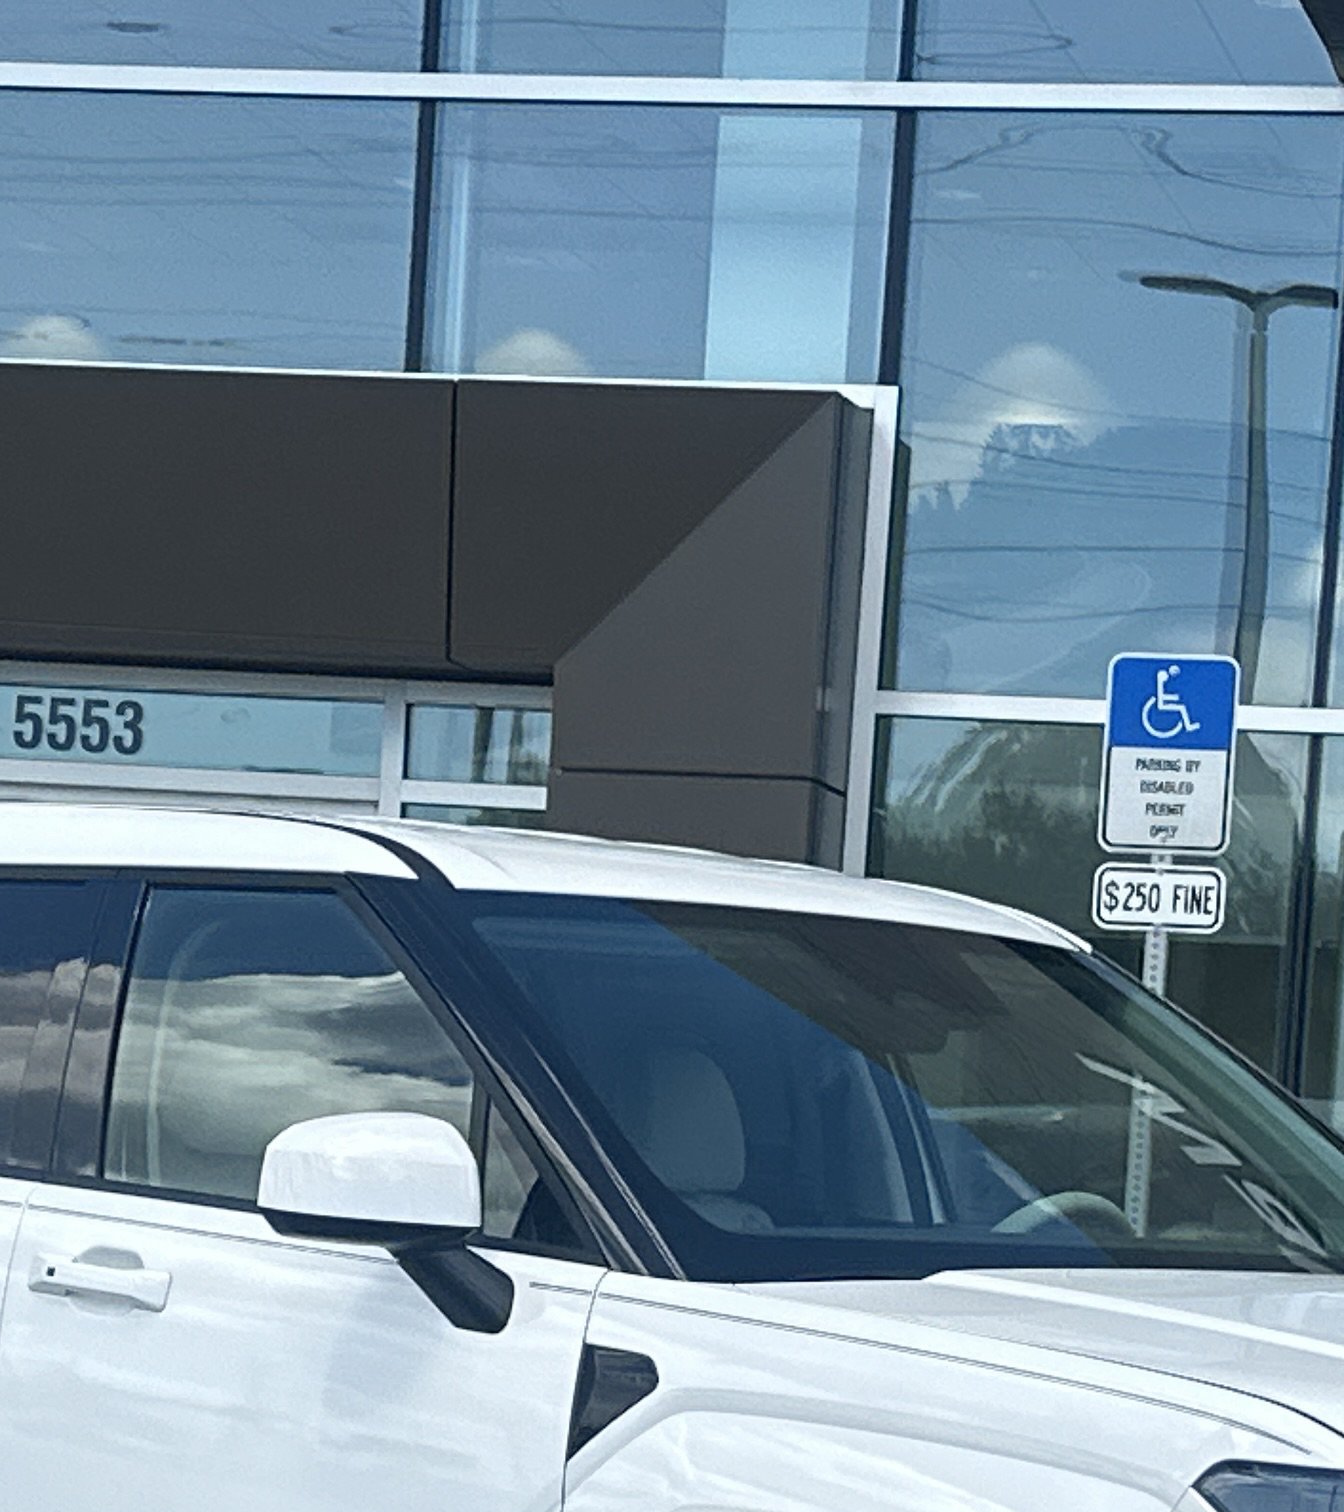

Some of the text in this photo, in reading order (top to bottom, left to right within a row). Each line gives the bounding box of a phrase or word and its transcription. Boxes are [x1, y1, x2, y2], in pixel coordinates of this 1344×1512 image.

[13, 695, 144, 755] 5553
[1186, 759, 1201, 773] BY
[1104, 880, 1215, 915] $250 FINE
